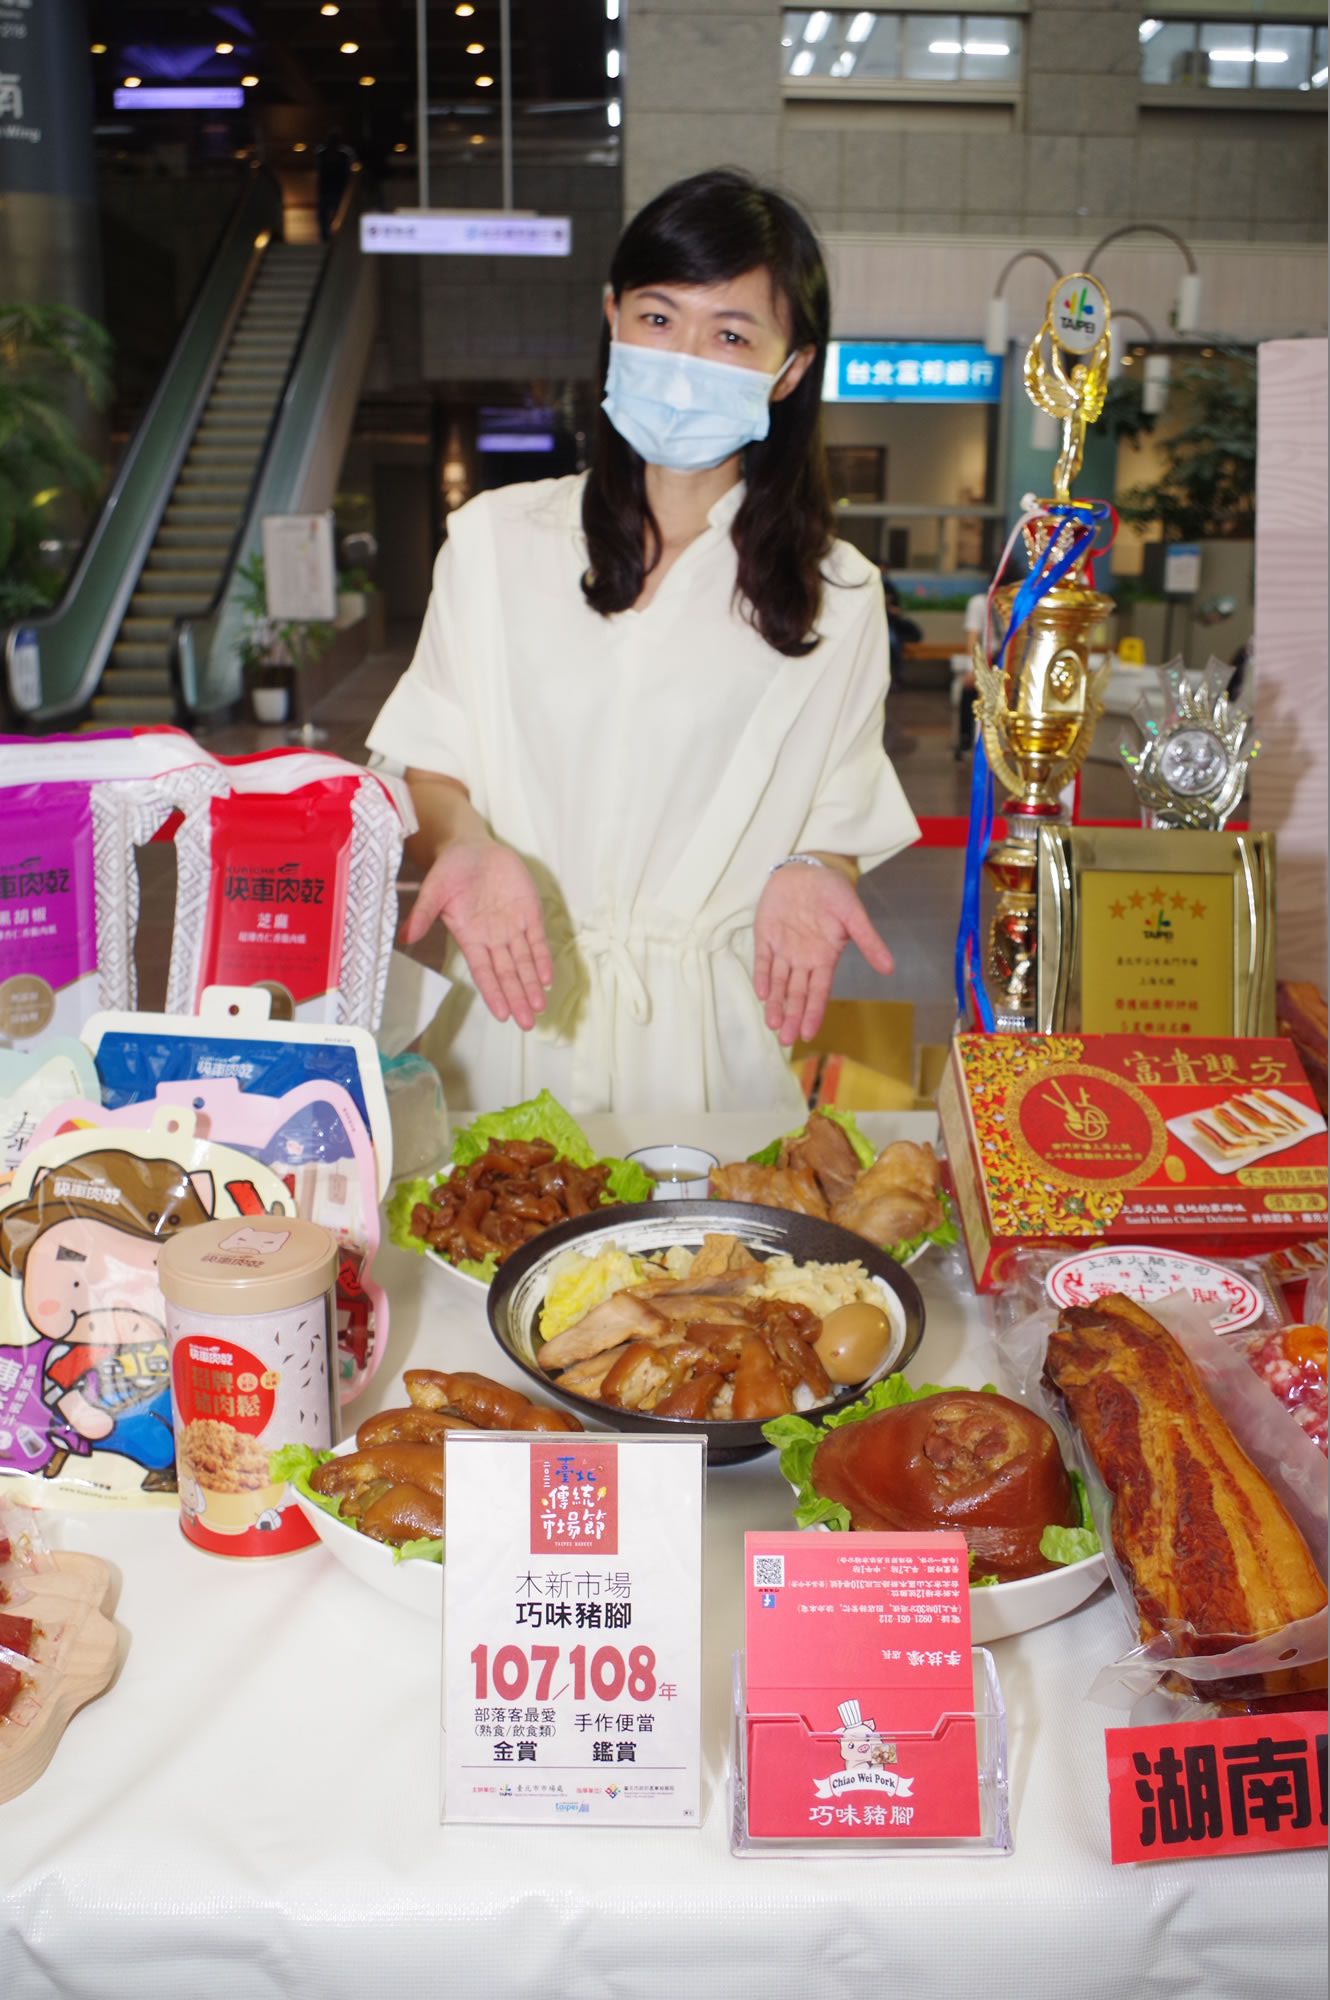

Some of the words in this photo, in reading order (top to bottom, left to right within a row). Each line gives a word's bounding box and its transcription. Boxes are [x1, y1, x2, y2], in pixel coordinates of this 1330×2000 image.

[1060, 316, 1096, 334] TAIPEI
[224, 875, 325, 905] 快車肉乾
[257, 912, 289, 929] 芝麻
[1123, 1047, 1287, 1085] 富貴雙方
[548, 1484, 596, 1510] 傳統
[540, 1508, 607, 1540] 市場節
[514, 1570, 633, 1599] 木新市場
[515, 1601, 632, 1630] 巧味豬腳
[474, 1707, 556, 1723] 部落客最愛
[574, 1713, 655, 1733] 手作便當
[474, 1724, 557, 1738] (熟食/飲食類)
[493, 1741, 538, 1762] 金賞
[592, 1741, 637, 1763] 鑑賞
[832, 1776, 856, 1789] Chiao
[857, 1773, 873, 1783] Wei
[875, 1774, 896, 1789] Pork
[1132, 1733, 1328, 1847] 湖南
[808, 1803, 914, 1827] 巧味豬腳
